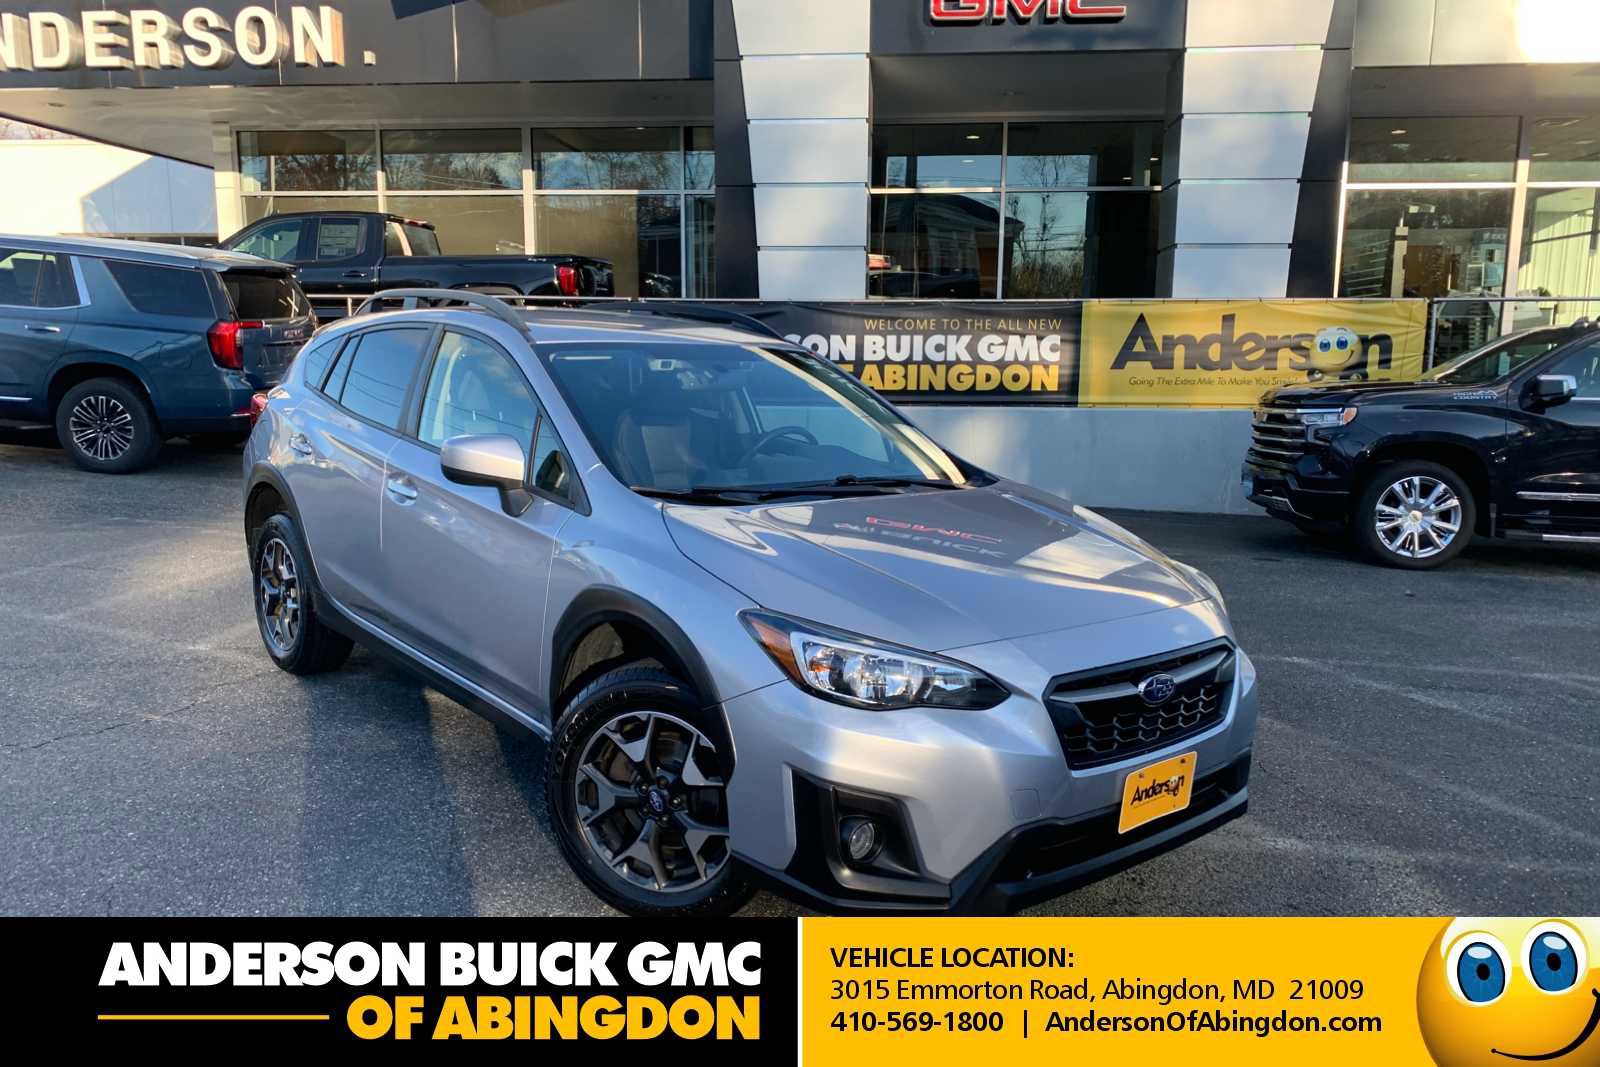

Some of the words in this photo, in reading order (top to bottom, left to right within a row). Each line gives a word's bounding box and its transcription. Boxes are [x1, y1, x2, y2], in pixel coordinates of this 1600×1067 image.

[864, 319, 936, 330] WELCOME
[943, 319, 961, 330] TO
[966, 319, 992, 330] THE
[997, 319, 1022, 330] ALL
[1028, 319, 1062, 330] NEW
[784, 334, 856, 361] ON
[863, 334, 973, 362] BUICK
[977, 334, 1061, 362] GMC
[860, 363, 1059, 391] ABINGDON
